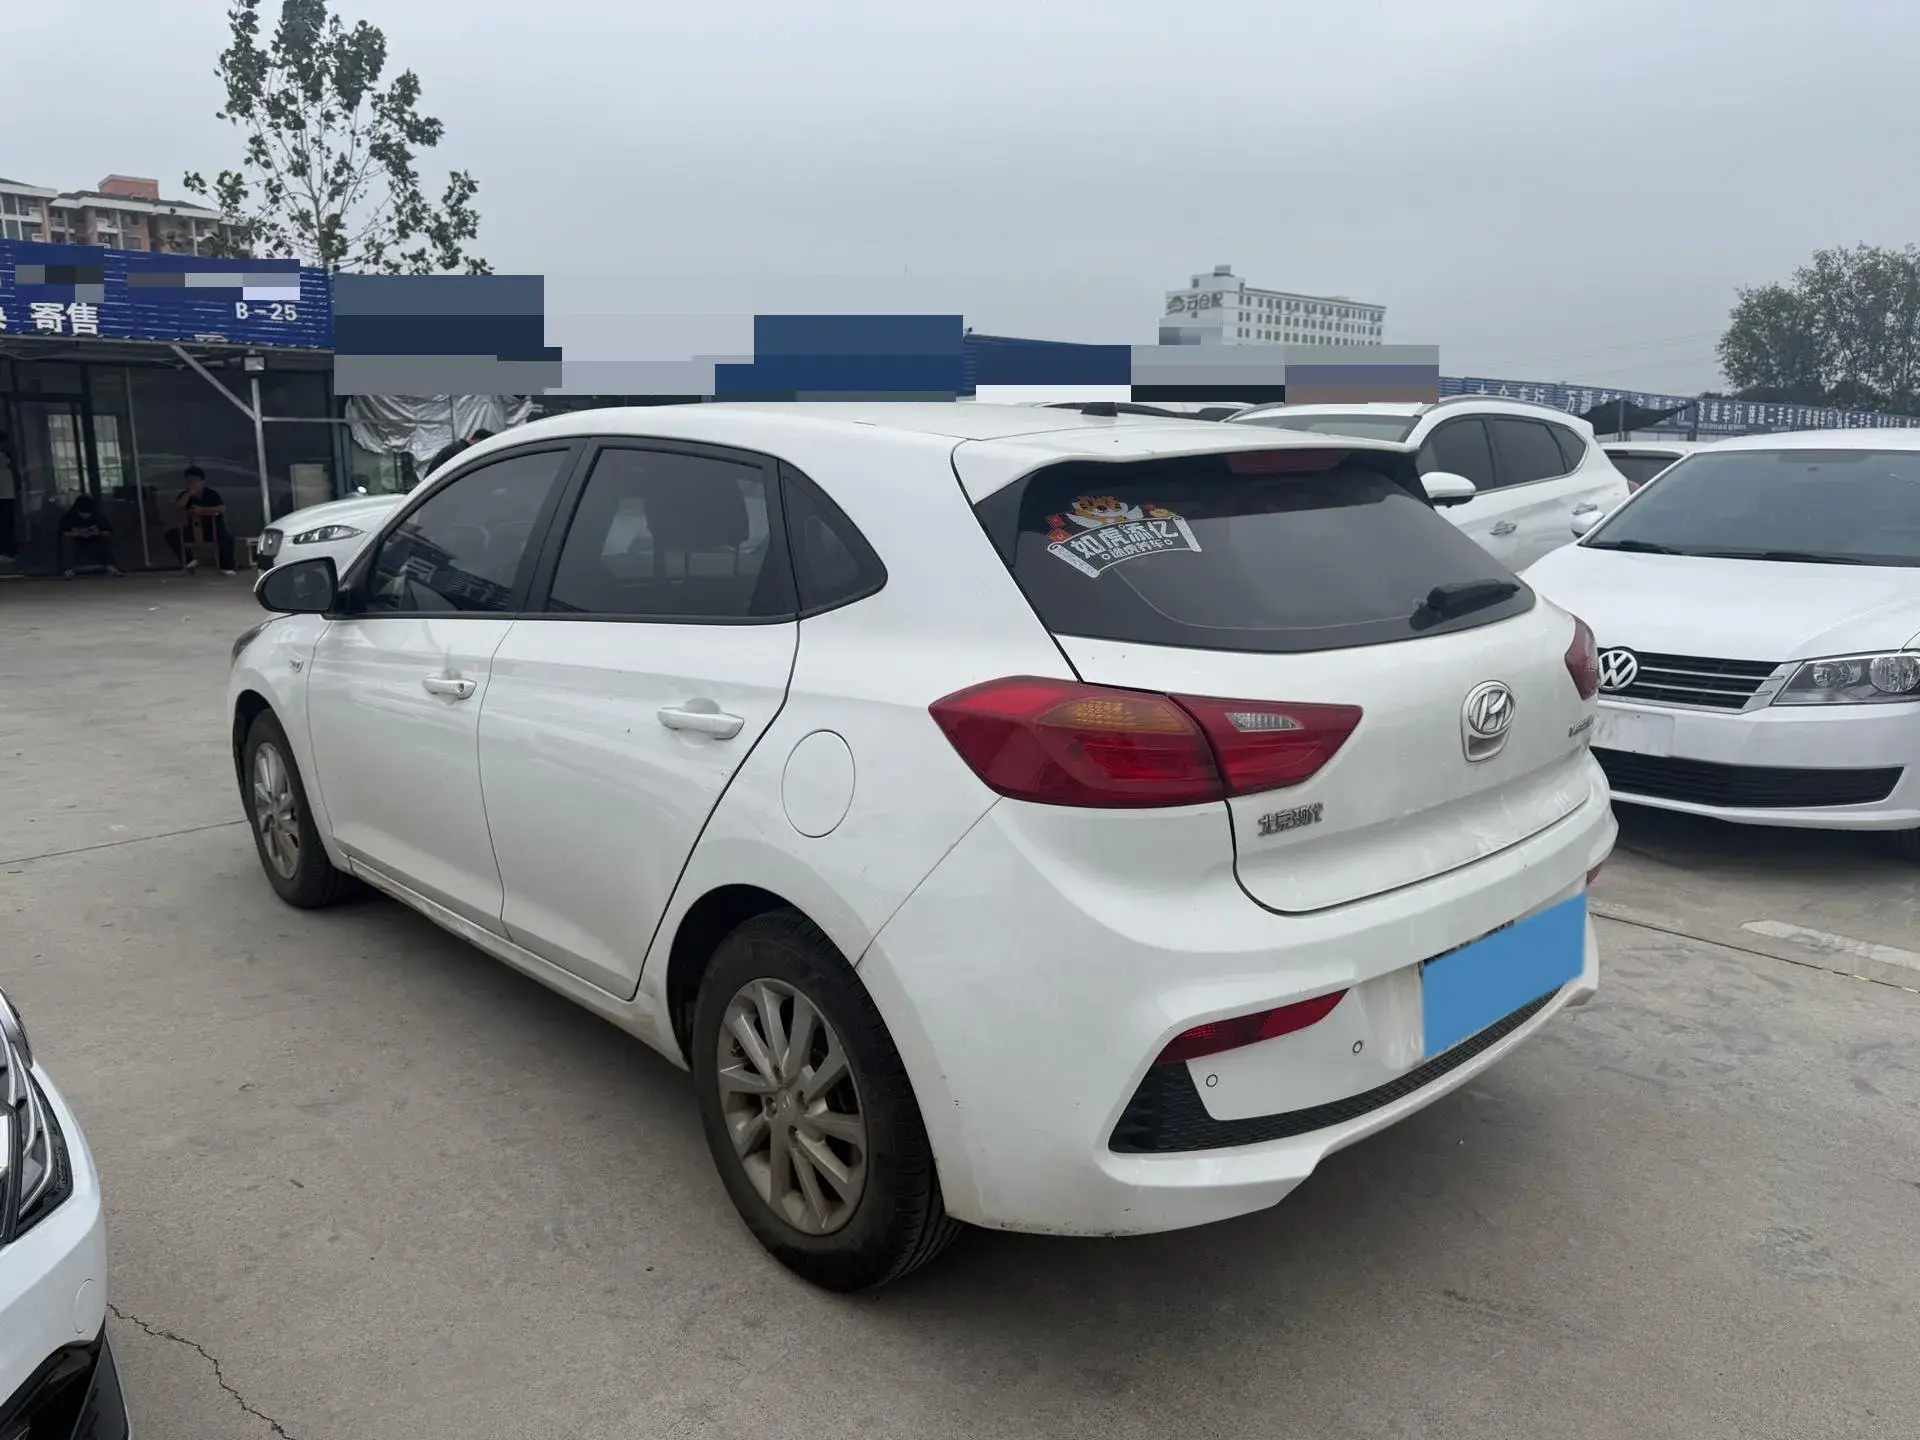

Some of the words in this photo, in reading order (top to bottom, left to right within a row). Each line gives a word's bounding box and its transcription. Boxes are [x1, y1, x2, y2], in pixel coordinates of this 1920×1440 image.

[30, 302, 99, 335] 寄售
[1258, 802, 1323, 836] 北京现代
